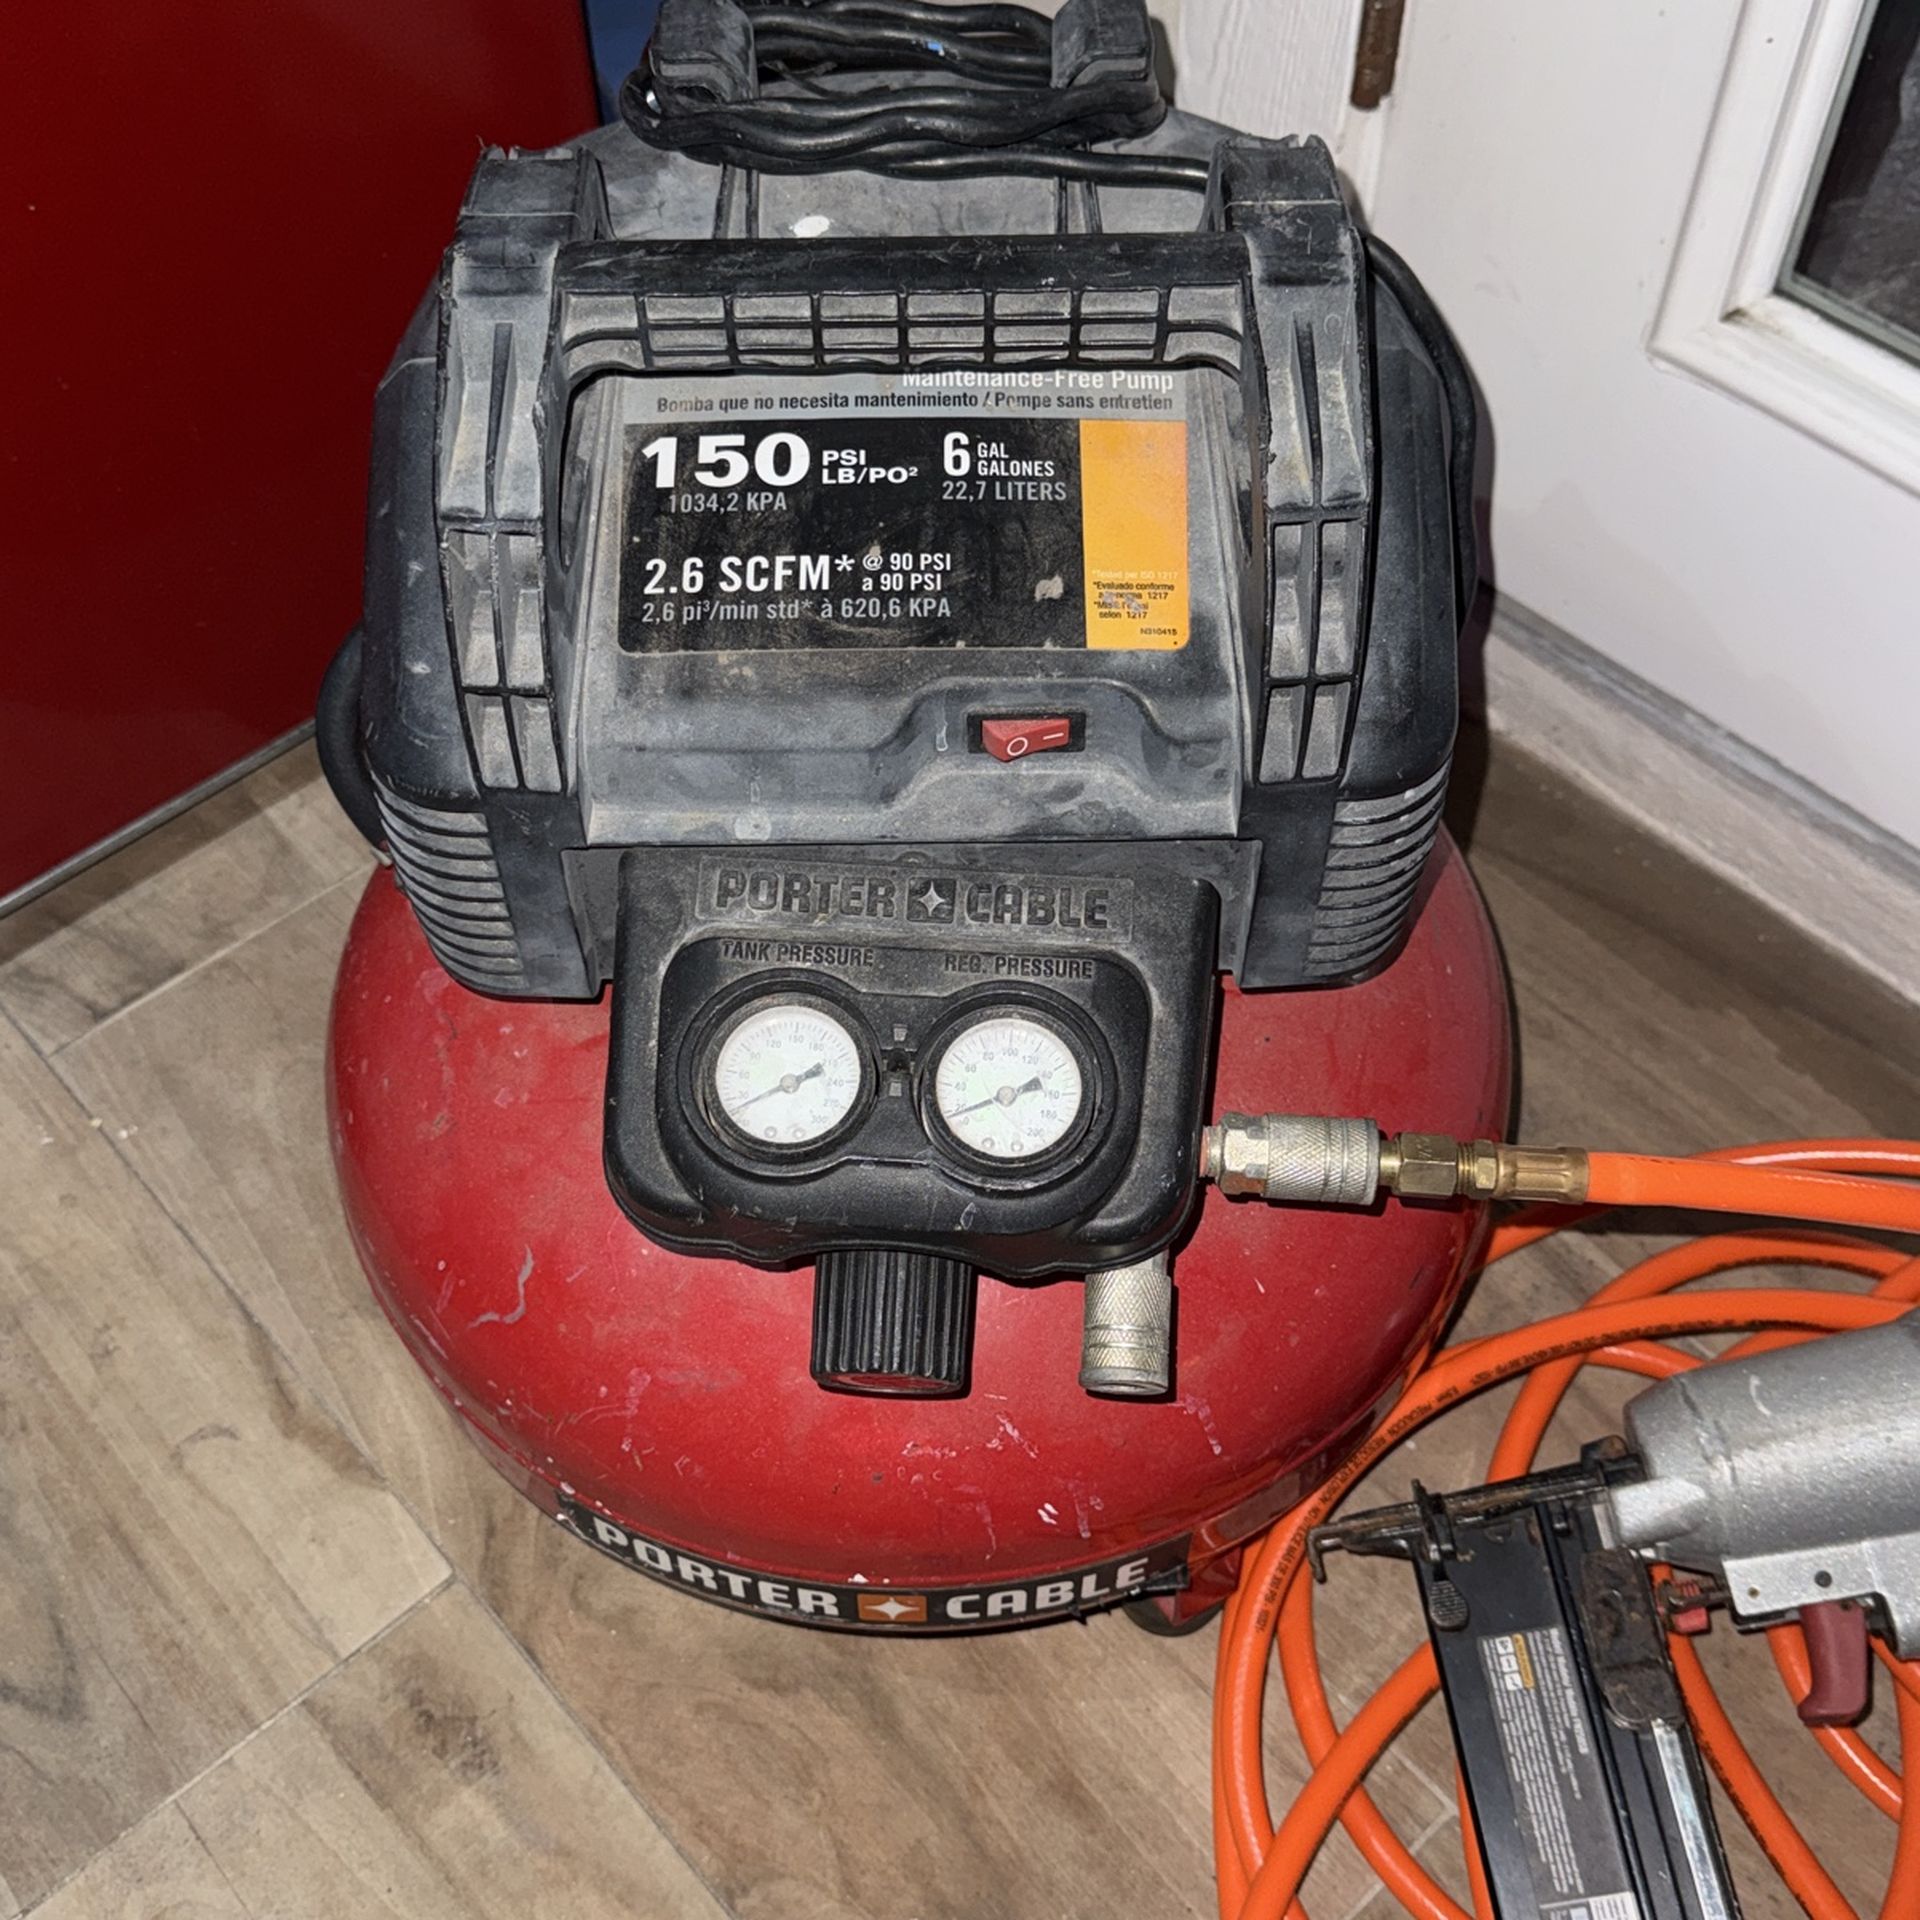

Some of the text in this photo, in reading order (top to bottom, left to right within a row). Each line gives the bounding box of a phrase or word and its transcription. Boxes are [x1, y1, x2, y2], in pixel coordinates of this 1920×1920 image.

[902, 371, 1174, 393] Maintenance-Free Pump
[657, 396, 713, 412] Bomba
[719, 396, 748, 413] que
[754, 396, 774, 410] no
[779, 393, 849, 408] necesita
[855, 391, 978, 407] mantenimiento
[995, 392, 1051, 410] Pompe
[1057, 394, 1094, 408] sans
[1099, 394, 1173, 409] entretien
[641, 433, 810, 489] 150
[822, 450, 866, 466] PSI
[943, 432, 969, 478] 6
[978, 442, 1009, 460] GAL
[977, 459, 1055, 478] GALONES
[668, 492, 787, 513] 1034,2 KPA
[942, 481, 1066, 503] 22,7 LITERS
[863, 553, 951, 570] @ 90 PSI
[643, 557, 704, 595] 2.6
[862, 572, 942, 591] a 90 PSI
[1136, 583, 1174, 591] conforme
[1148, 592, 1168, 600] 1217
[642, 602, 675, 623] 2,6
[821, 599, 833, 618] à
[841, 598, 901, 620] 620,6
[909, 598, 951, 618] KPA
[1099, 611, 1121, 619] selon
[716, 870, 1110, 928] PORTER CABLE
[721, 940, 874, 968] TANK PRESSURE
[945, 955, 1093, 980] REG. PRESSURE
[766, 1039, 782, 1048] 120
[788, 1034, 804, 1044] 150
[594, 1517, 1149, 1620] PORTER CABLE
